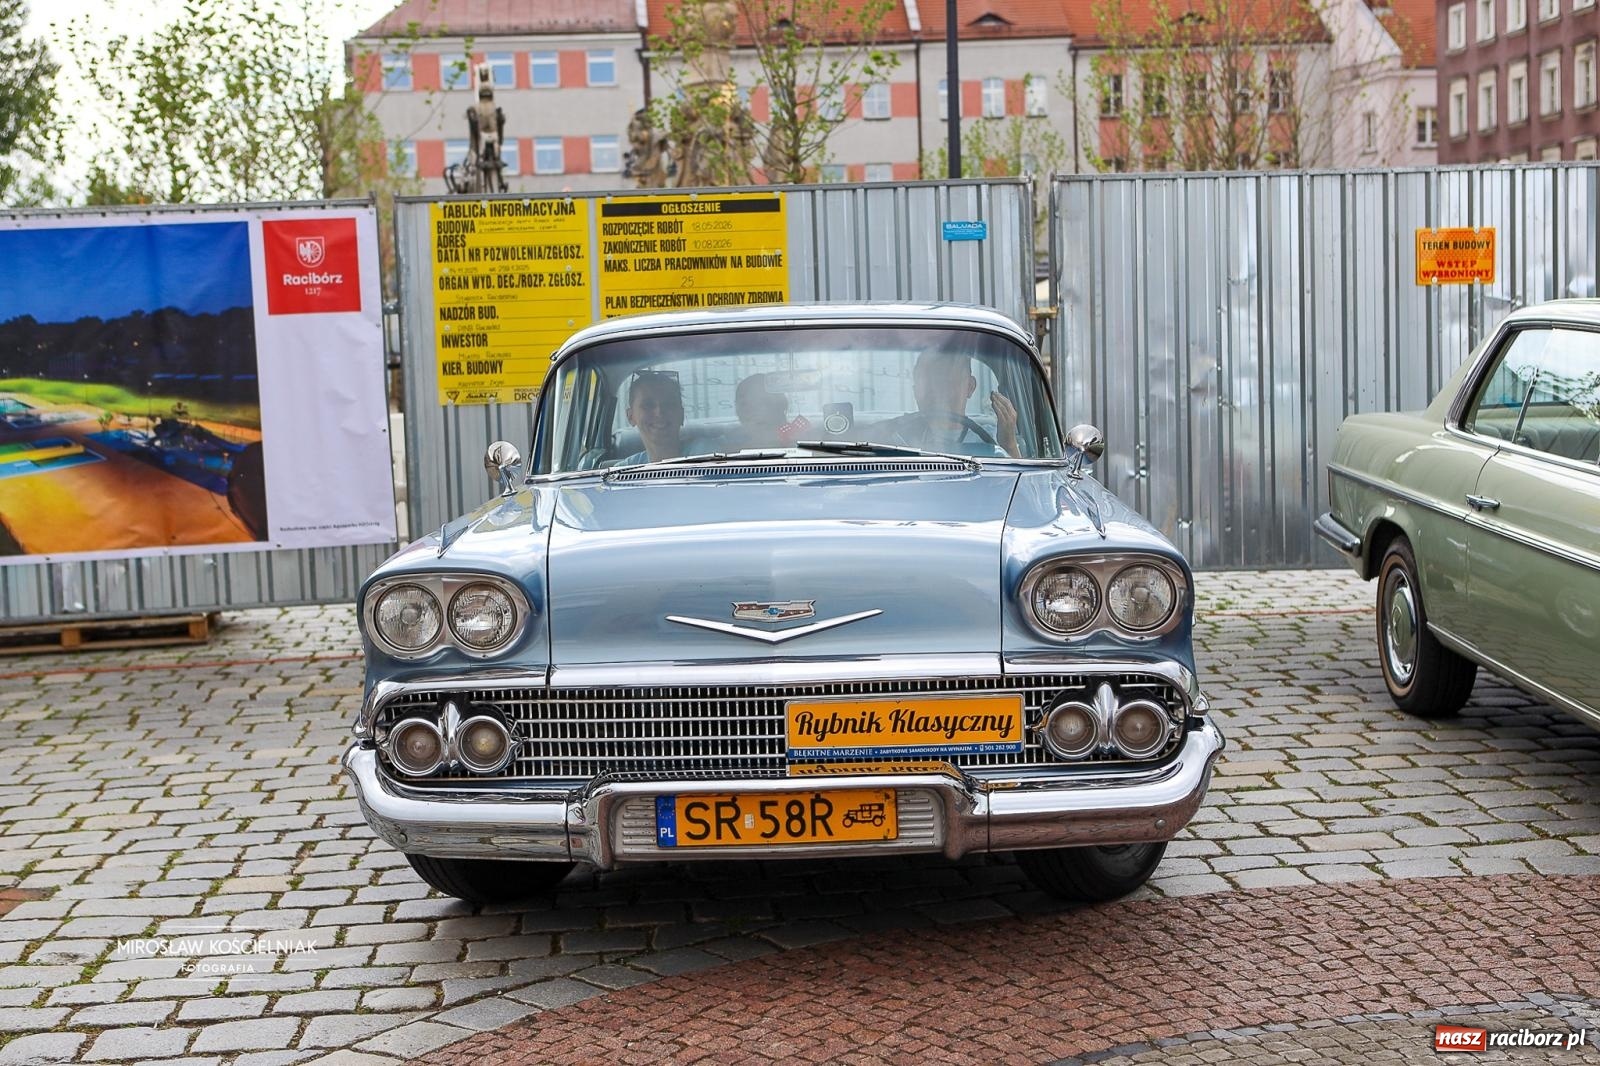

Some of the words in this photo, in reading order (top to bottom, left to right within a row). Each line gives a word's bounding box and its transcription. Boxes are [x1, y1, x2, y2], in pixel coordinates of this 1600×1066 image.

[443, 203, 486, 219] TABLICA
[490, 201, 576, 217] INFORMACYJNA
[661, 202, 721, 214] OGŁOSZENIE
[437, 220, 475, 234] BUDOWA
[603, 221, 654, 237] ROZPOCZĘCIE
[657, 218, 684, 234] ROBÓT
[437, 235, 466, 248] ADRES
[603, 238, 658, 254] ZAKOŃCZENIE
[660, 236, 686, 252] ROBÓT
[1422, 241, 1450, 251] TEREN
[1453, 240, 1490, 250] BUDOWY
[437, 249, 460, 263] DATA
[462, 249, 466, 262] I
[468, 248, 481, 262] NR
[483, 245, 584, 261] POZWOLENIA/ZGŁOSZ.
[604, 258, 631, 273] MAKS.
[634, 257, 661, 271] LICZBA
[664, 254, 727, 271] PRACOWNIKÓW
[731, 256, 743, 268] NA
[746, 254, 782, 268] BUDOWIE
[282, 271, 343, 286] Racibórz
[439, 274, 471, 290] ORGAN
[472, 274, 495, 289] WYD.
[497, 273, 546, 289] DEC./ROZP.
[548, 272, 585, 287] ZGŁOSZ.
[1422, 269, 1490, 279] WZBRONIONY
[680, 276, 695, 289] 25
[305, 287, 321, 296] 1217
[605, 295, 628, 309] PLAN
[630, 291, 699, 309] BEZPIECZEŃSTWA
[701, 294, 705, 306] I
[707, 292, 746, 306] OCHRONY
[747, 291, 784, 304] ZDROWIA
[440, 304, 476, 321] NADZÓR
[478, 305, 499, 320] BUD.
[441, 333, 488, 348] INWESTOR
[442, 362, 465, 376] KIER.
[467, 360, 503, 375] BUDOWY
[794, 710, 885, 743] Rybnik
[888, 708, 1015, 740] Klasyczny
[793, 748, 831, 758] BŁĘKITNE
[832, 748, 873, 757] MARZENIE
[684, 801, 742, 840] SR
[759, 798, 834, 839] 58R
[660, 827, 674, 838] PL
